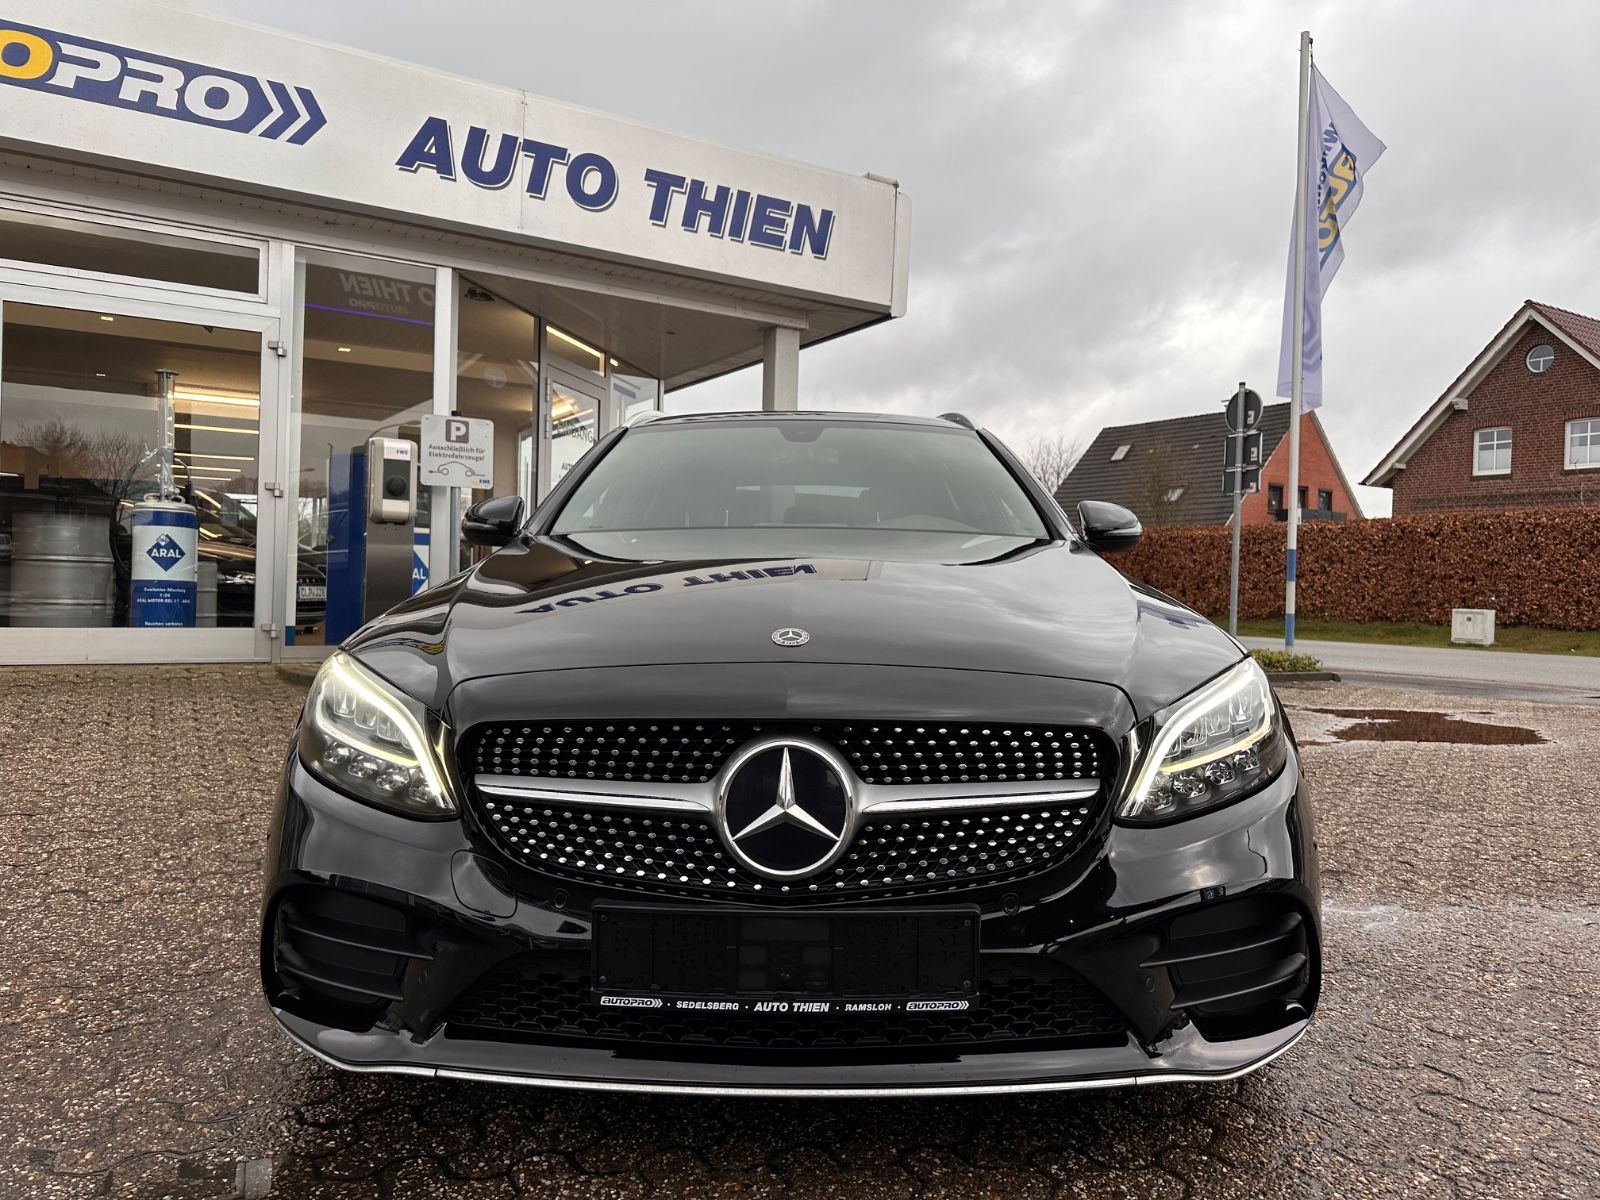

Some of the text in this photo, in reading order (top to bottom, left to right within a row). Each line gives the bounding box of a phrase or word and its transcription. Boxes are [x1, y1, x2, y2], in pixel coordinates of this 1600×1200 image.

[395, 116, 836, 260] AUTO THIEN
[450, 421, 467, 442] P
[428, 444, 475, 453] Ausschließlich
[150, 548, 182, 558] ARAL
[676, 1000, 740, 1011] SEDELSBERG
[753, 1001, 789, 1012] AUTO
[792, 1002, 830, 1013] THIEN
[844, 1003, 892, 1012] RAMSLOH
